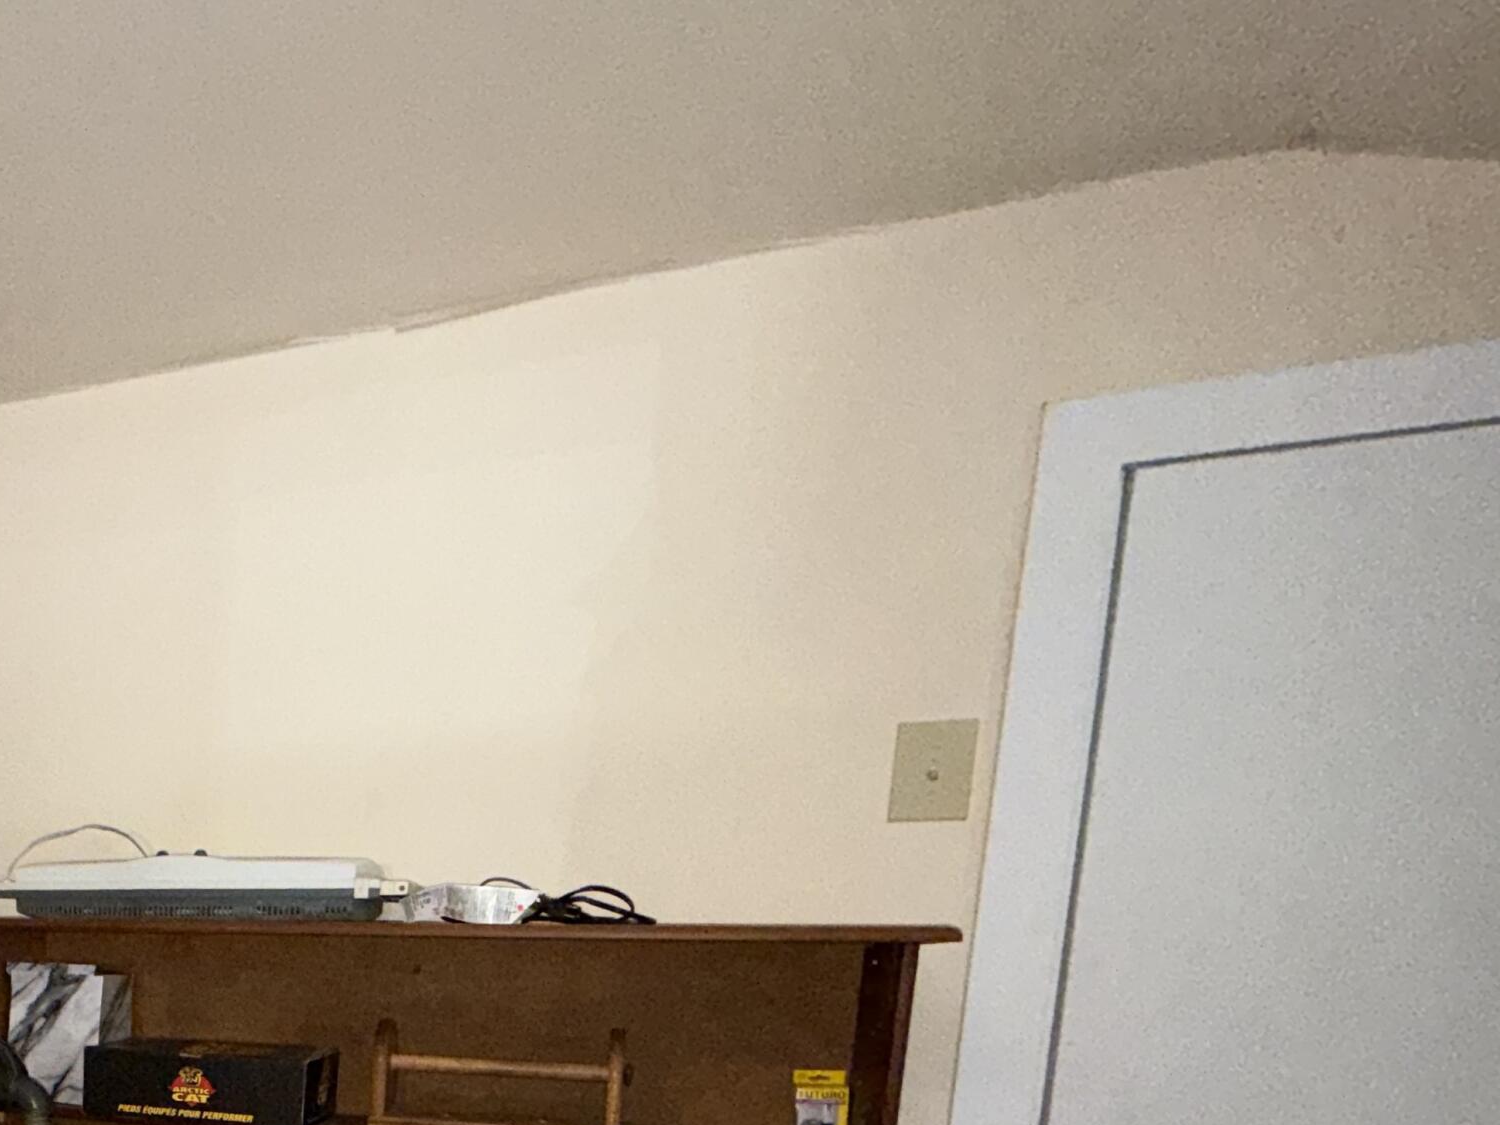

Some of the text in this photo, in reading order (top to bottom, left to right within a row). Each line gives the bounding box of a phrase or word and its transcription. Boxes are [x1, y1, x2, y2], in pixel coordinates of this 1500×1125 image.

[172, 1086, 210, 1095] ARCTIC
[171, 1093, 210, 1103] CAT
[117, 1103, 141, 1113] PIEDS
[178, 1108, 201, 1118] POUR
[202, 1110, 254, 1123] PERFORMER
